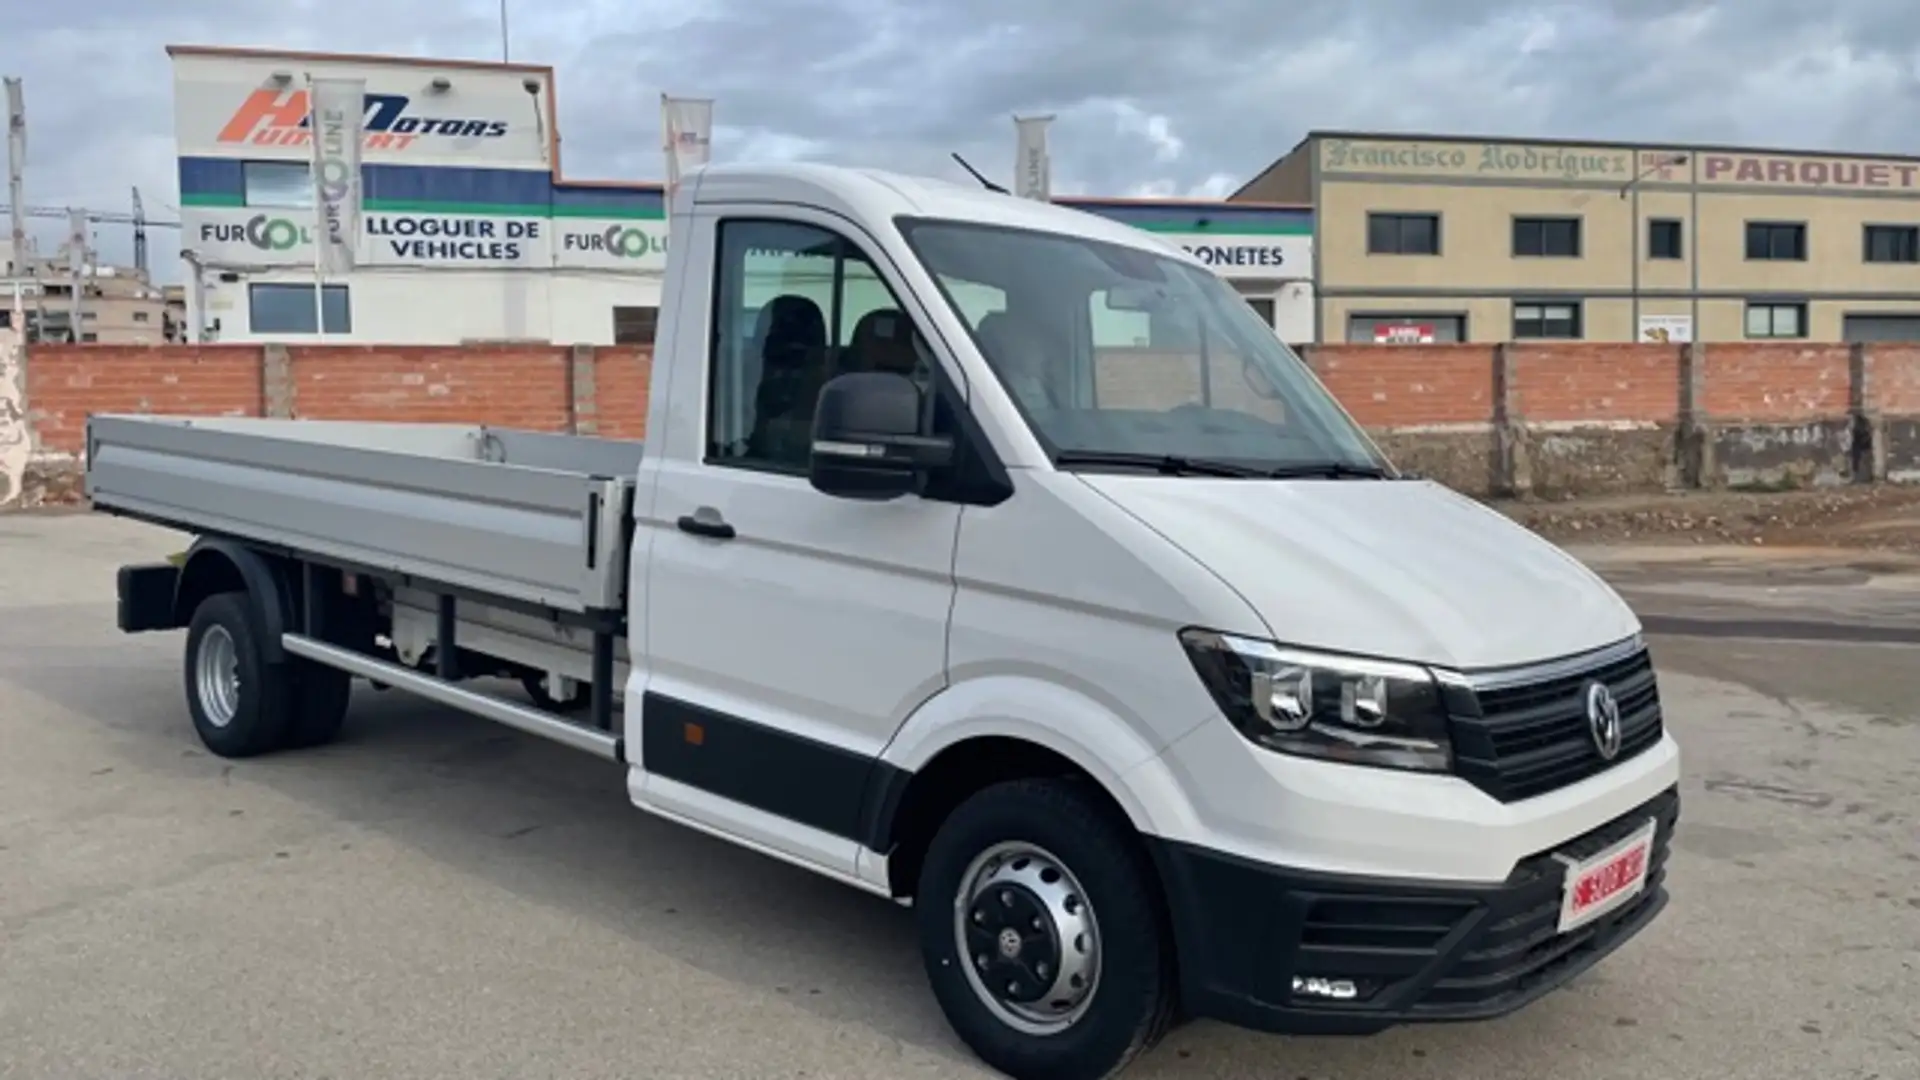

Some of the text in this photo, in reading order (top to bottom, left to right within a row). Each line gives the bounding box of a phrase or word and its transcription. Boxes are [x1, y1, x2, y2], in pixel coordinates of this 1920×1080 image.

[1705, 156, 1919, 189] PARQUET
[366, 217, 540, 239] LLOGUER DE
[390, 240, 521, 260] VEHICLES
[1181, 245, 1284, 266] ONETES
